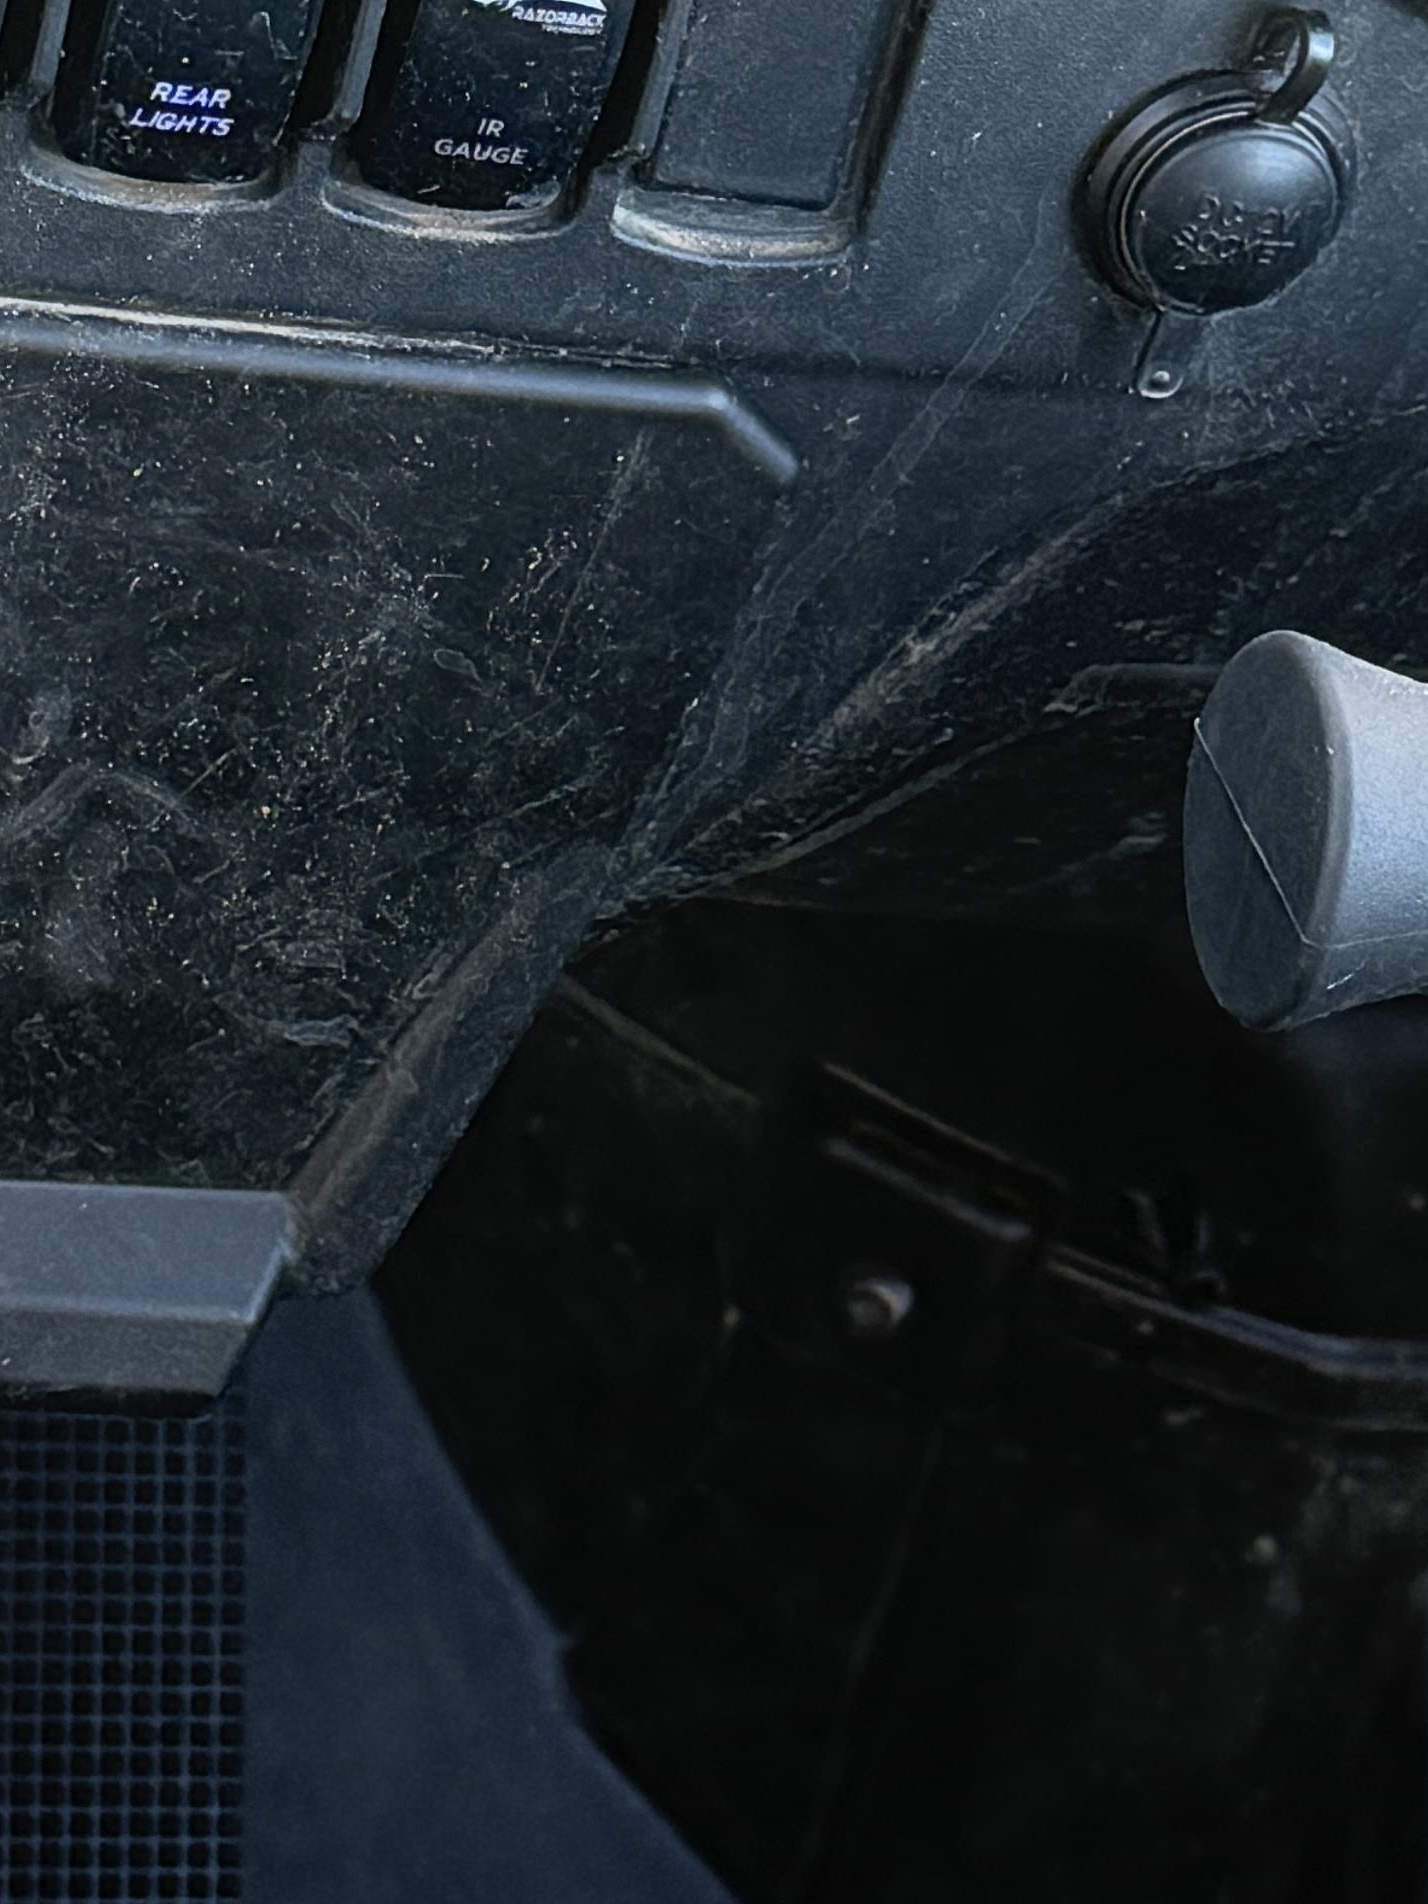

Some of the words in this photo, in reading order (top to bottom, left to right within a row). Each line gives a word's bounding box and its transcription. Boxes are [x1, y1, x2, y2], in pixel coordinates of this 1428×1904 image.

[511, 5, 607, 28] RAZORBACK
[150, 81, 232, 109] REAR
[129, 107, 235, 136] LIGHTS
[477, 117, 505, 138] IR
[434, 138, 529, 165] GAUGE
